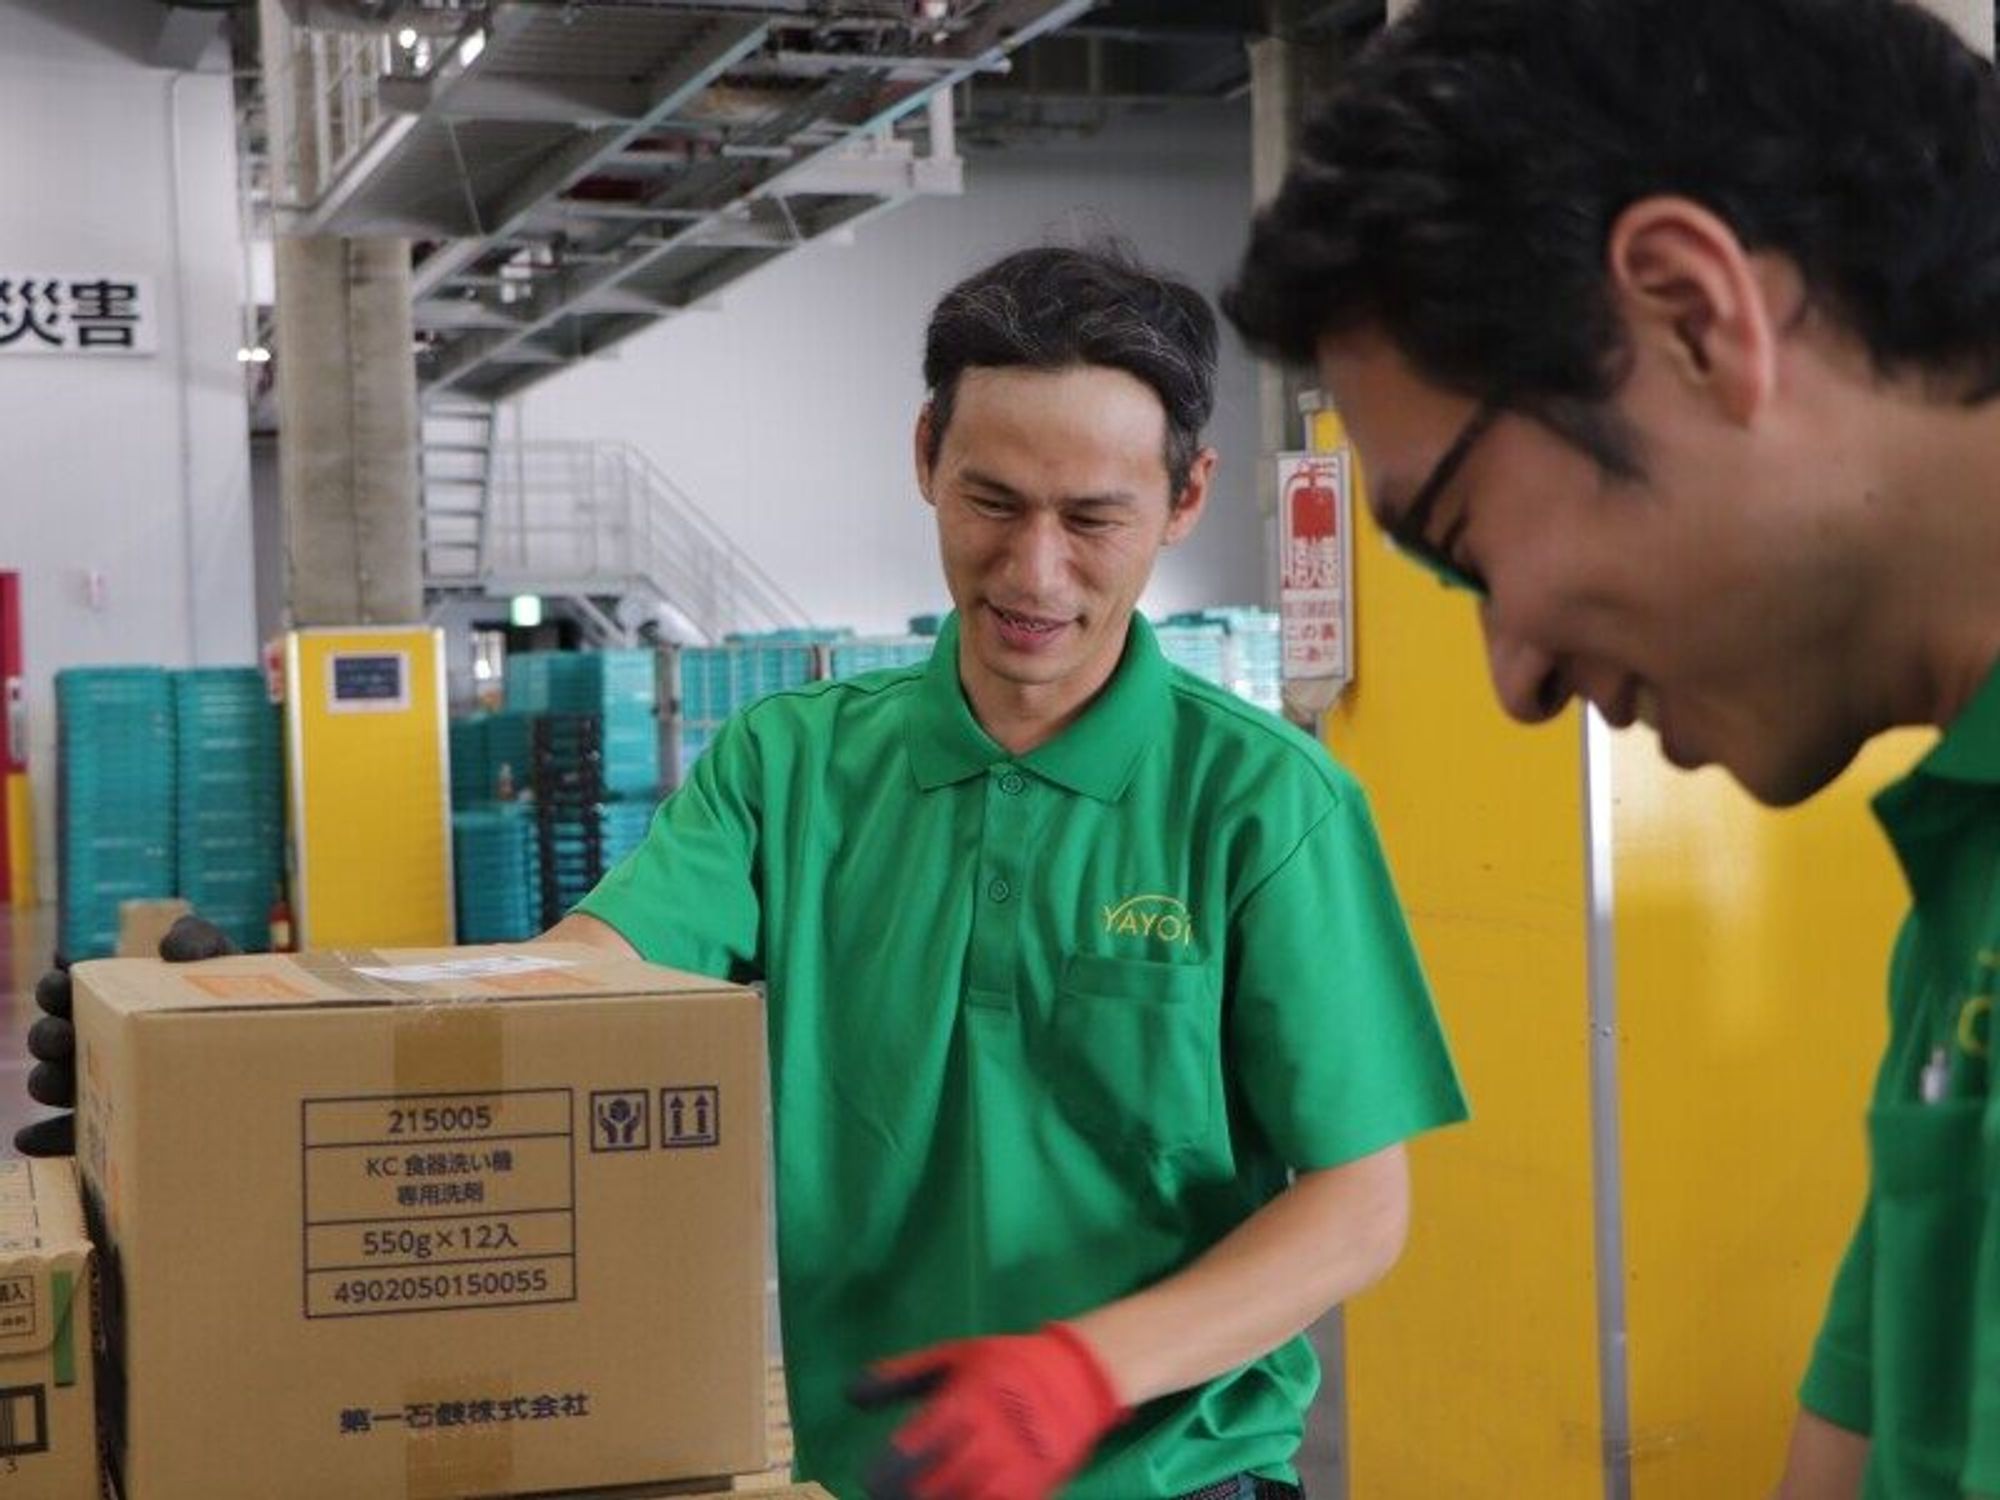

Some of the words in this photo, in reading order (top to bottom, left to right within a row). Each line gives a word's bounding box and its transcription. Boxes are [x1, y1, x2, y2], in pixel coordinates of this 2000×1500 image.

[0, 280, 140, 347] 災害
[388, 1105, 492, 1134] 215005
[366, 1157, 398, 1177] KC
[335, 1269, 548, 1304] 4902050150055
